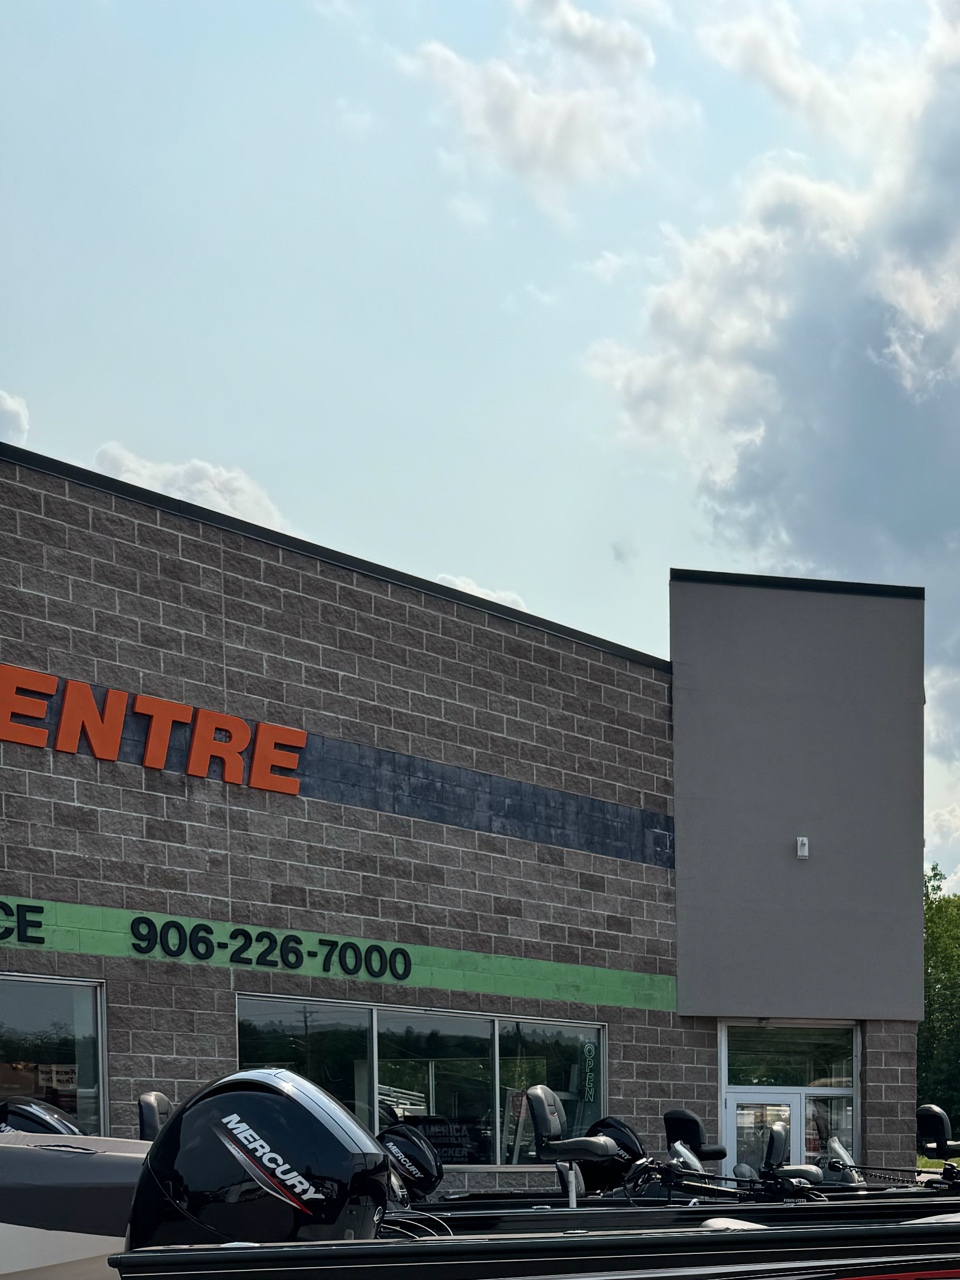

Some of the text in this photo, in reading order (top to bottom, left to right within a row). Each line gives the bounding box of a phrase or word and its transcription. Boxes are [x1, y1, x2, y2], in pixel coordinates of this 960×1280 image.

[0, 664, 307, 796] ENTRE
[130, 916, 412, 980] 906-226-7000
[584, 1043, 595, 1102] OPEN
[221, 1113, 326, 1201] MERCURY
[385, 1141, 425, 1179] MERCURY
